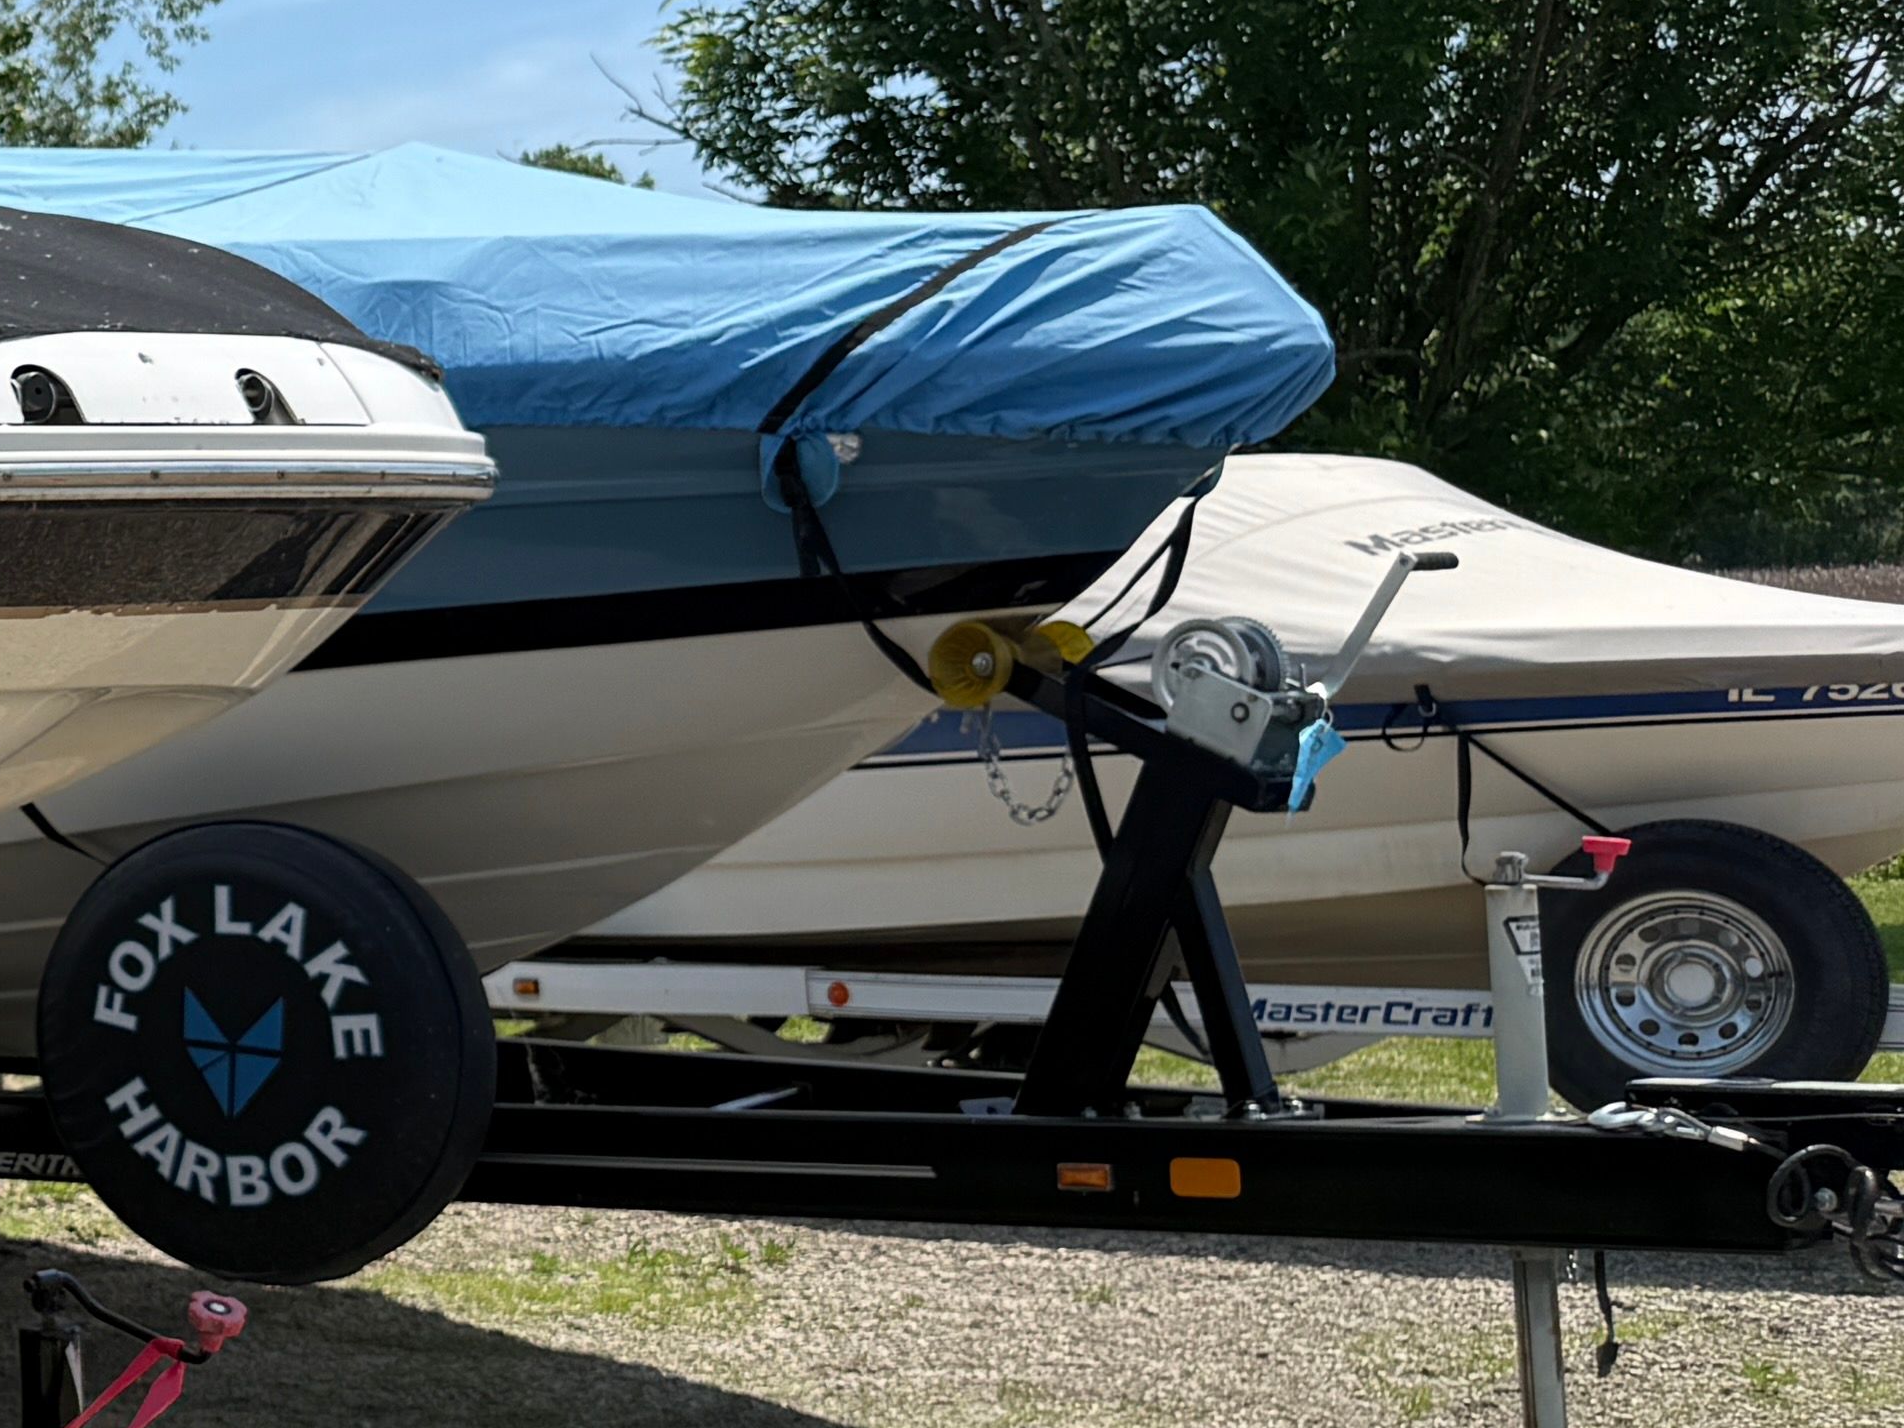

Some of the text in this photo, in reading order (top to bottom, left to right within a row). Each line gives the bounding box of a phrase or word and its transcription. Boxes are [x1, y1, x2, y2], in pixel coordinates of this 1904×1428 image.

[94, 884, 384, 1060] FOX LAKE
[106, 1076, 368, 1207] HARBOR
